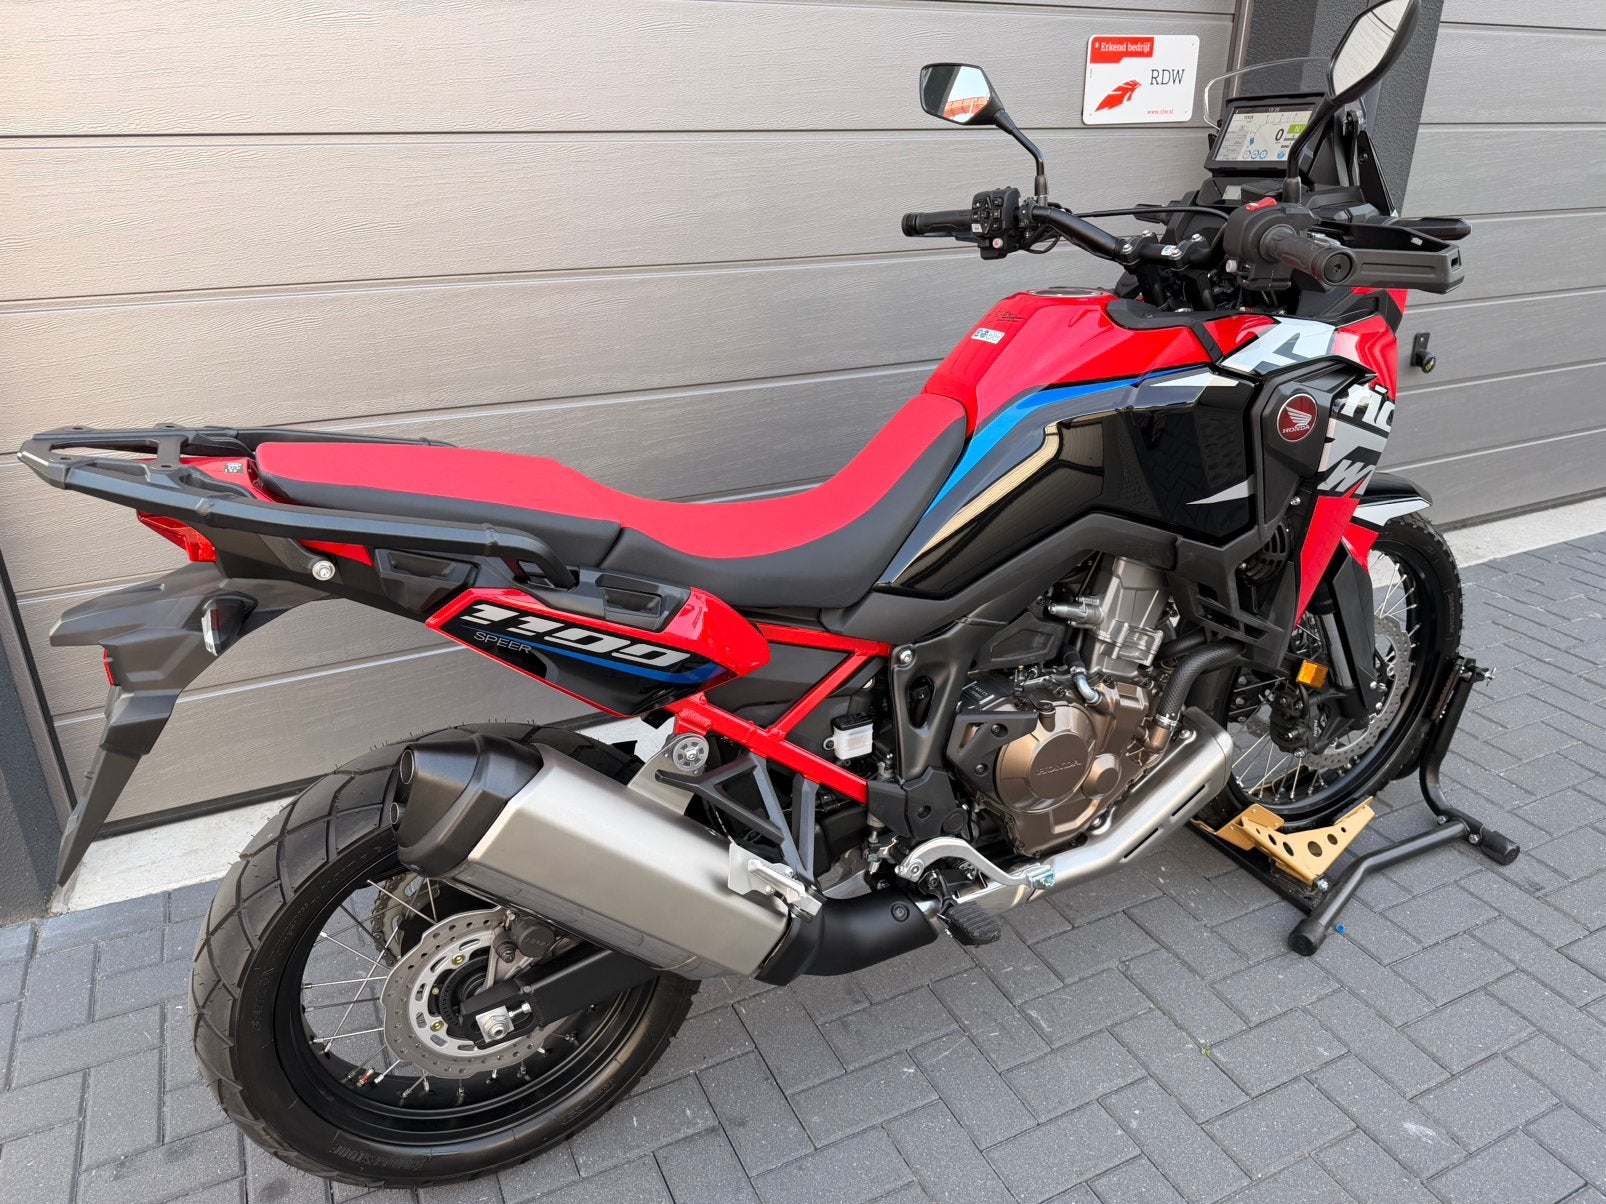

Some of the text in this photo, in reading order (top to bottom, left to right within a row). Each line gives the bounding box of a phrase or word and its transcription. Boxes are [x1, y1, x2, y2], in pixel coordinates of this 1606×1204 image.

[1101, 42, 1151, 54] Erkend bedrijf
[1150, 69, 1185, 85] RDW
[1282, 424, 1311, 434] HONDA
[460, 603, 691, 667] 1100
[473, 631, 532, 654] SPEER
[1036, 760, 1083, 776] HONDA
